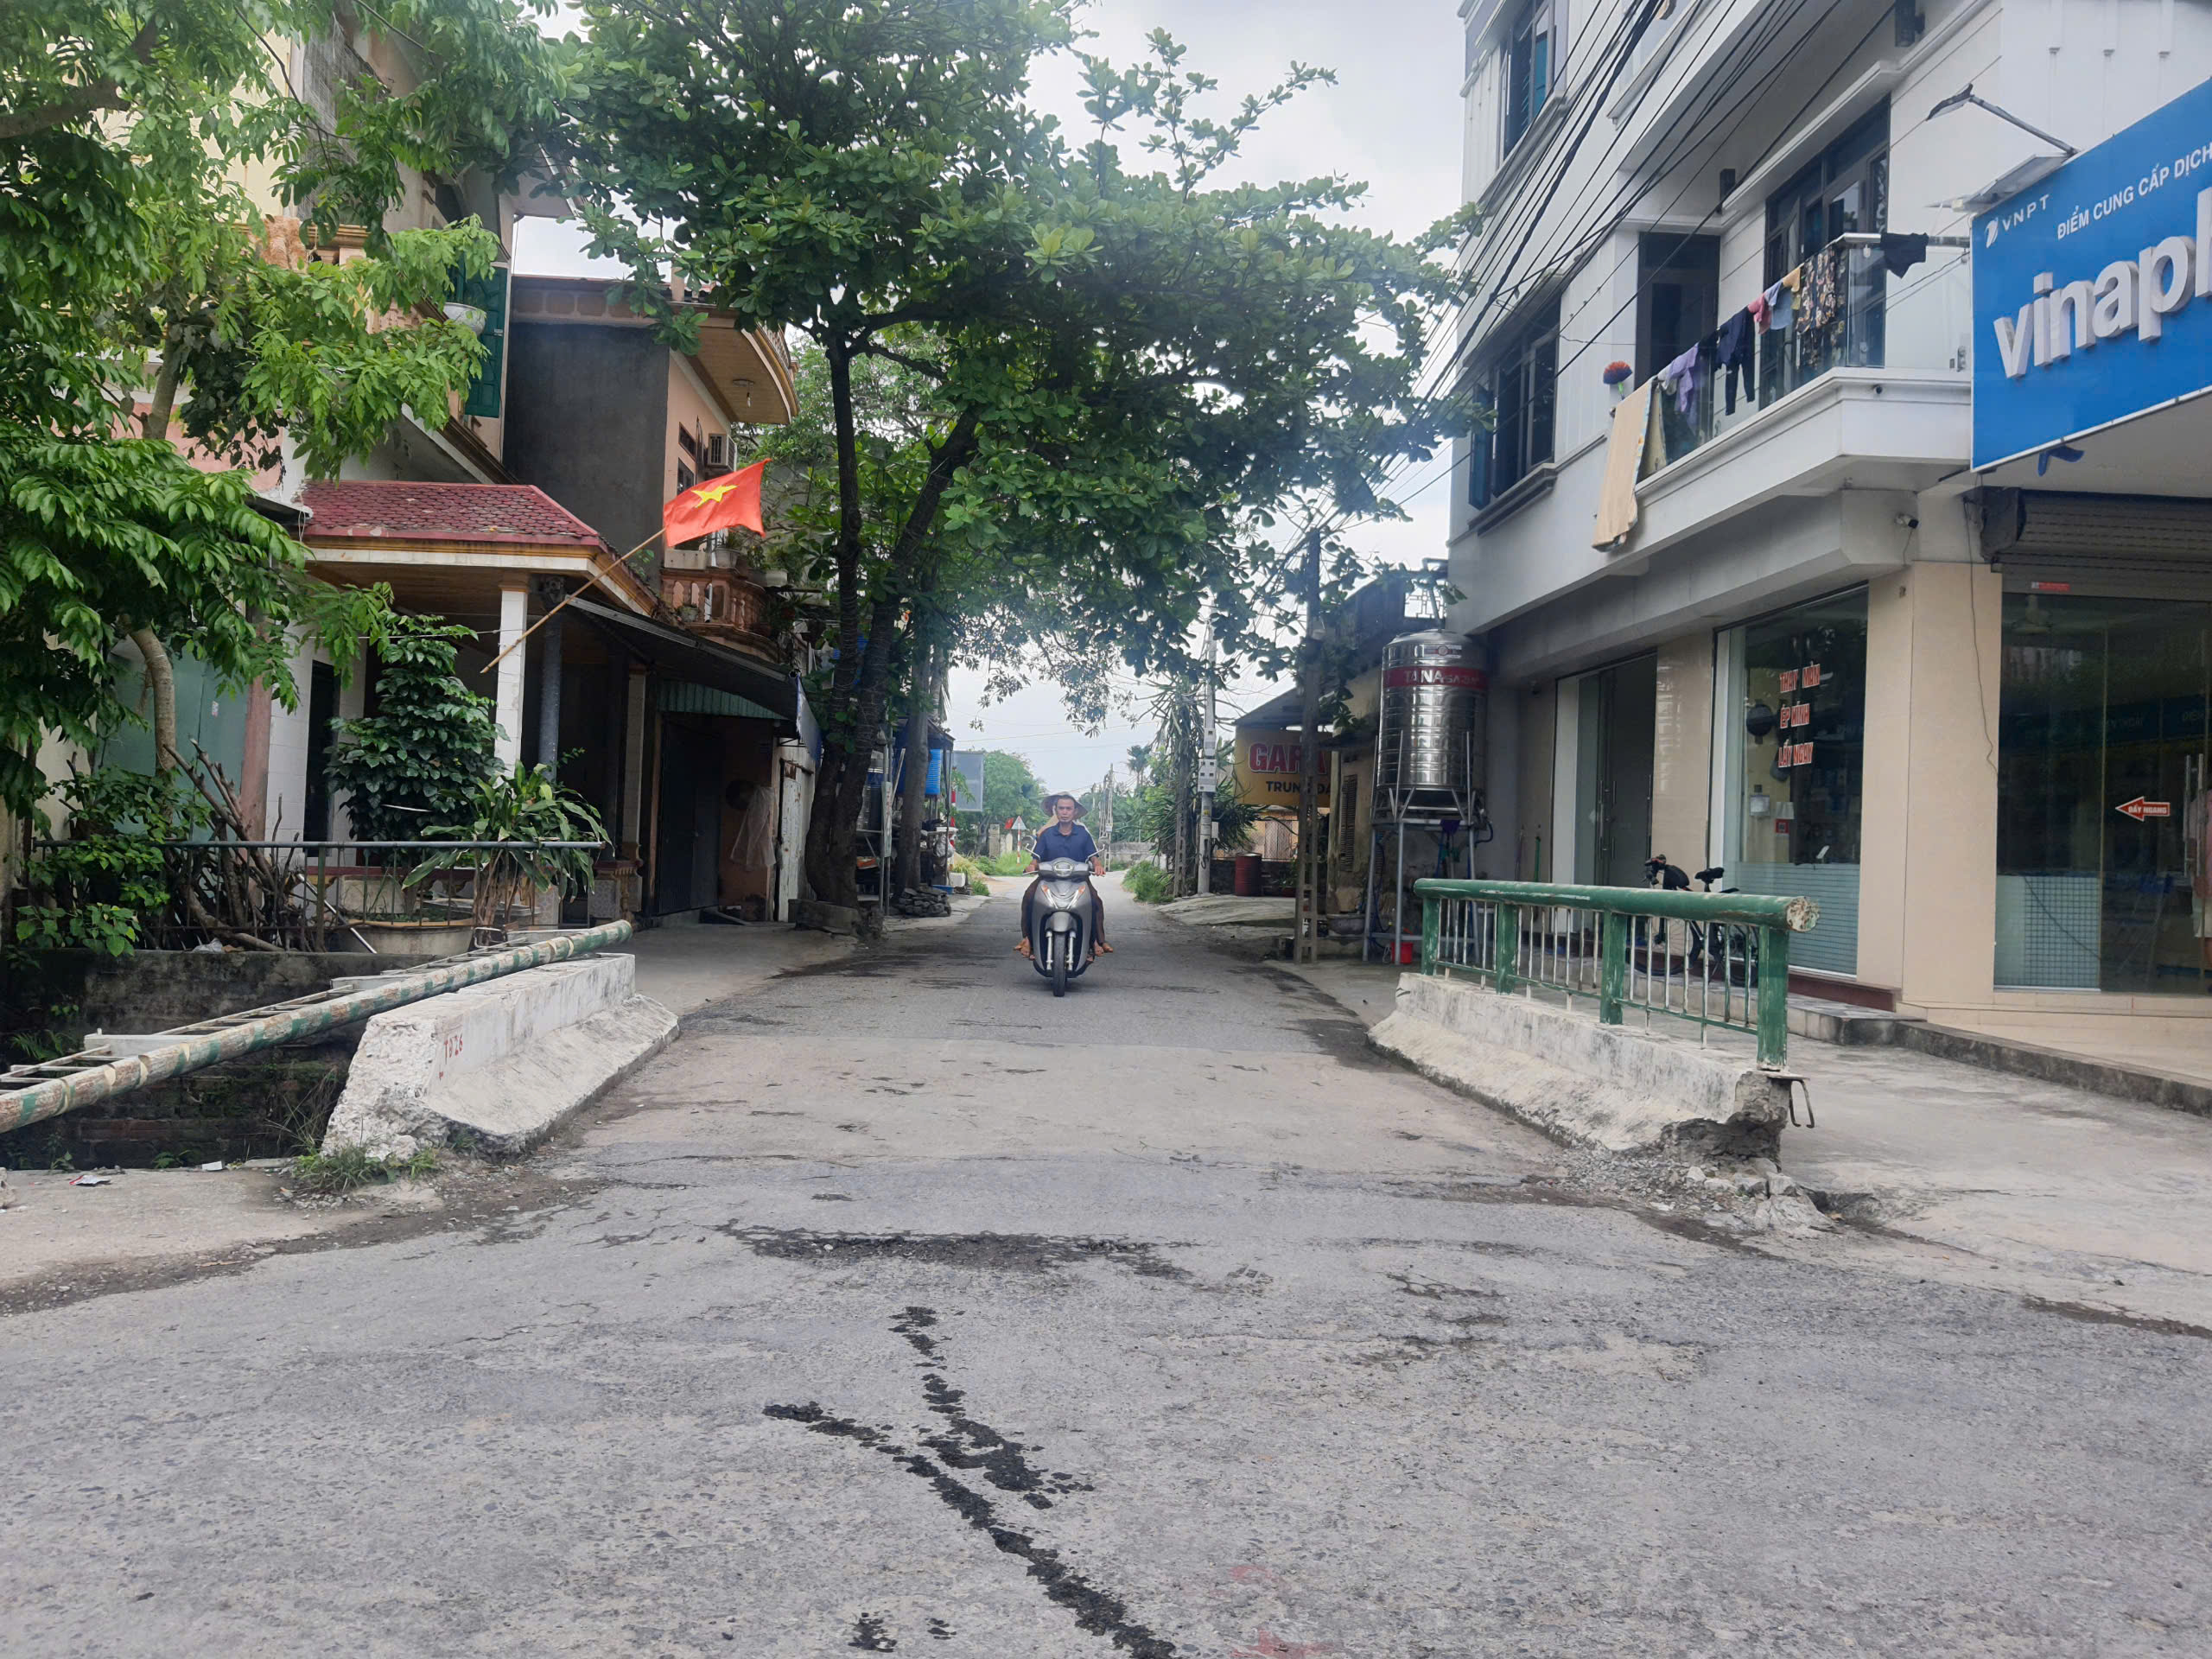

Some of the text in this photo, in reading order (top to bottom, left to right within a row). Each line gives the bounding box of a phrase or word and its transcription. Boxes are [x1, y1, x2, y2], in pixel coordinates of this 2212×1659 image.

[2002, 194, 2050, 232] VNPT
[2057, 142, 2212, 240] ĐIỂM CUNG CẤP DỊCH
